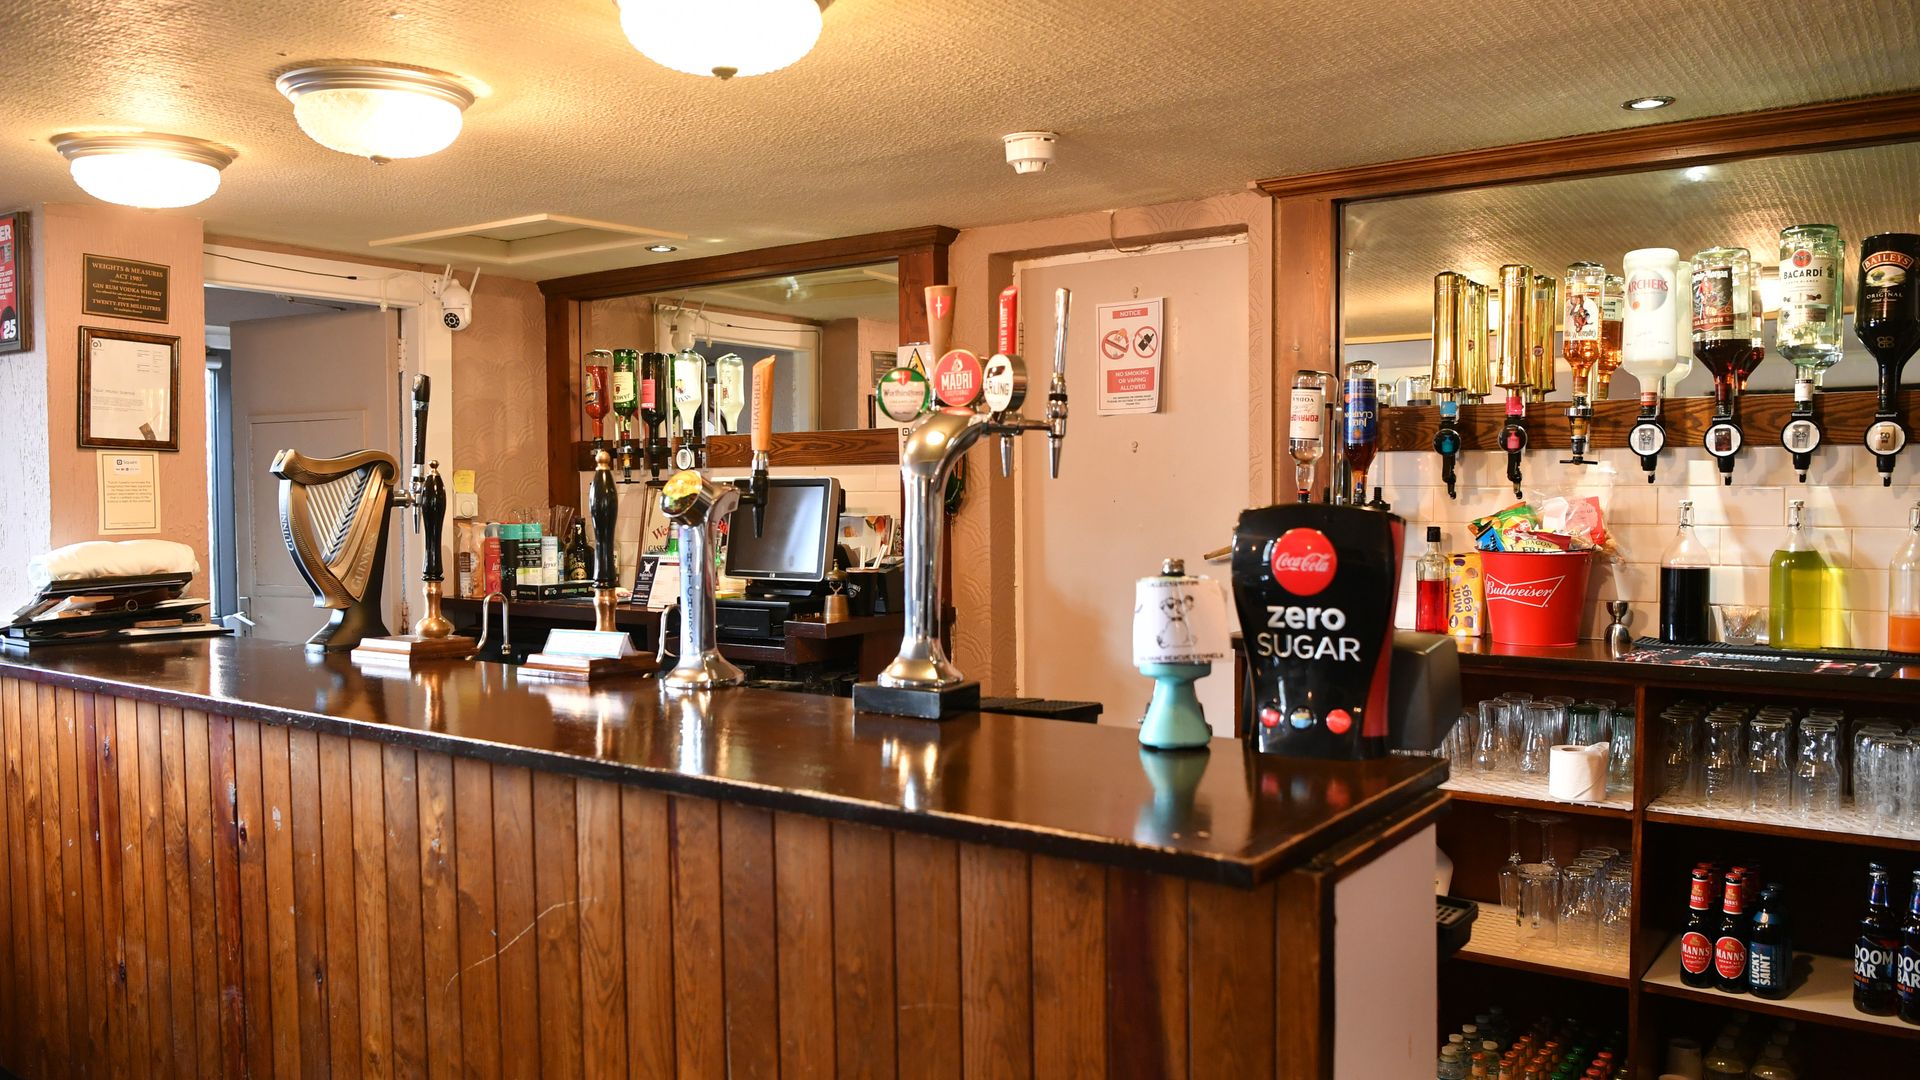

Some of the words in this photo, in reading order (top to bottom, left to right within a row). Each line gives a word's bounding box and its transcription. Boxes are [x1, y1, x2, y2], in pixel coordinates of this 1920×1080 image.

[92, 262, 124, 272] WEIGHTS
[131, 267, 163, 278] MEASURES
[1864, 253, 1910, 268] BAILEYS
[119, 286, 140, 294] VODKA
[140, 288, 162, 297] WHISKY
[1628, 278, 1669, 292] ARCHERS
[1866, 291, 1903, 300] ORIGINAL
[1119, 309, 1142, 318] NOTICE
[3, 319, 17, 339] 25
[1124, 369, 1150, 377] SMOKING
[752, 374, 761, 430] THATCHERS
[1880, 432, 1891, 440] 50
[1525, 540, 1553, 549] BACON
[1274, 552, 1332, 572] Coca-Cola
[686, 539, 694, 643] THATCHERS
[1461, 584, 1475, 612] eggs
[1486, 579, 1553, 598] Budweiser
[1450, 588, 1464, 614] Mini
[1266, 605, 1347, 632] zero
[1256, 632, 1362, 663] SUGAR
[1682, 943, 1710, 956] MANNS
[1716, 948, 1745, 961] MANNS
[1854, 943, 1894, 965] DOOM
[1751, 951, 1760, 985] LUCKY
[1760, 953, 1771, 986] SAINT
[1854, 962, 1878, 980] BAR
[1897, 967, 1920, 988] BAR
